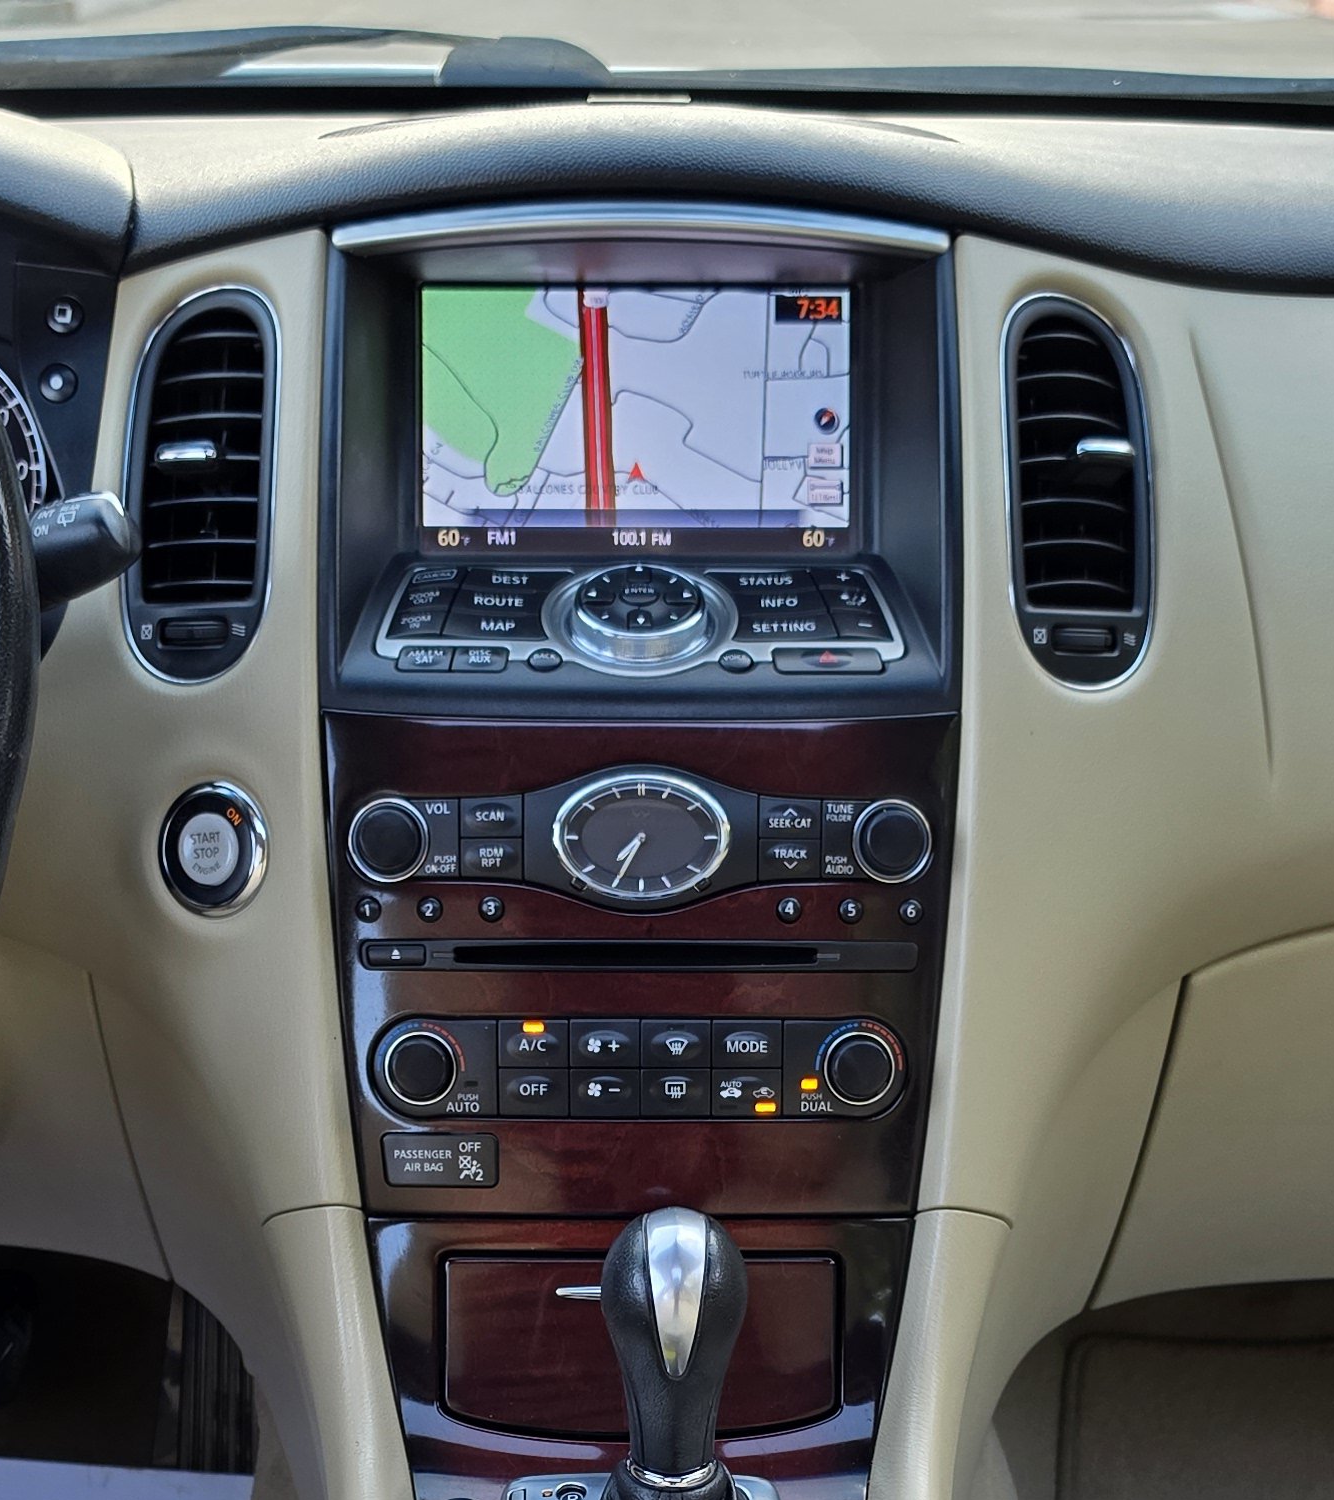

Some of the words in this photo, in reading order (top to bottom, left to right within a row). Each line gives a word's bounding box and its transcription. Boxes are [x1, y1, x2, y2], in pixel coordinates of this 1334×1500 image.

[796, 297, 839, 320] 7:34
[33, 524, 50, 537] ON
[487, 530, 517, 546] FM1
[612, 530, 647, 546] 100.1
[651, 530, 673, 546] FM
[491, 575, 529, 585] DEST
[739, 576, 794, 586] STATUS
[473, 596, 524, 608] ROUTE
[760, 597, 799, 608] INFO
[480, 620, 516, 632] MAP
[752, 621, 816, 633] SETTING
[415, 655, 435, 664] SAT
[468, 655, 492, 664] AUX
[425, 803, 451, 815] VOL
[826, 803, 855, 814] TUNE
[226, 806, 244, 827] ON
[475, 811, 505, 822] SCAN
[825, 814, 853, 822] FOLDER
[190, 831, 221, 845] START
[193, 846, 220, 859] STOP
[479, 847, 504, 858] RDM
[773, 848, 808, 860] TRACK
[434, 855, 457, 864] PUSH
[481, 858, 501, 868] RPT
[825, 855, 848, 864] PUSH
[191, 861, 222, 876] ENGINE
[825, 864, 854, 875] AUDIO
[363, 903, 371, 917] 1
[424, 903, 434, 917] 2
[486, 902, 496, 915] 3
[784, 903, 794, 915] 4
[847, 904, 856, 917] 5
[906, 904, 916, 918] 6
[518, 1039, 547, 1052] A/C
[726, 1040, 768, 1054] MODE
[519, 1083, 548, 1096] OFF
[720, 1080, 742, 1089] AUTO
[457, 1093, 479, 1101] PUSH
[801, 1093, 823, 1101] PUSH
[445, 1101, 480, 1113] AUTO
[800, 1101, 834, 1113] DUAL
[458, 1141, 482, 1153] OFF
[393, 1149, 452, 1160] PASSENGER
[403, 1162, 422, 1173] AIR
[423, 1162, 444, 1173] BAG
